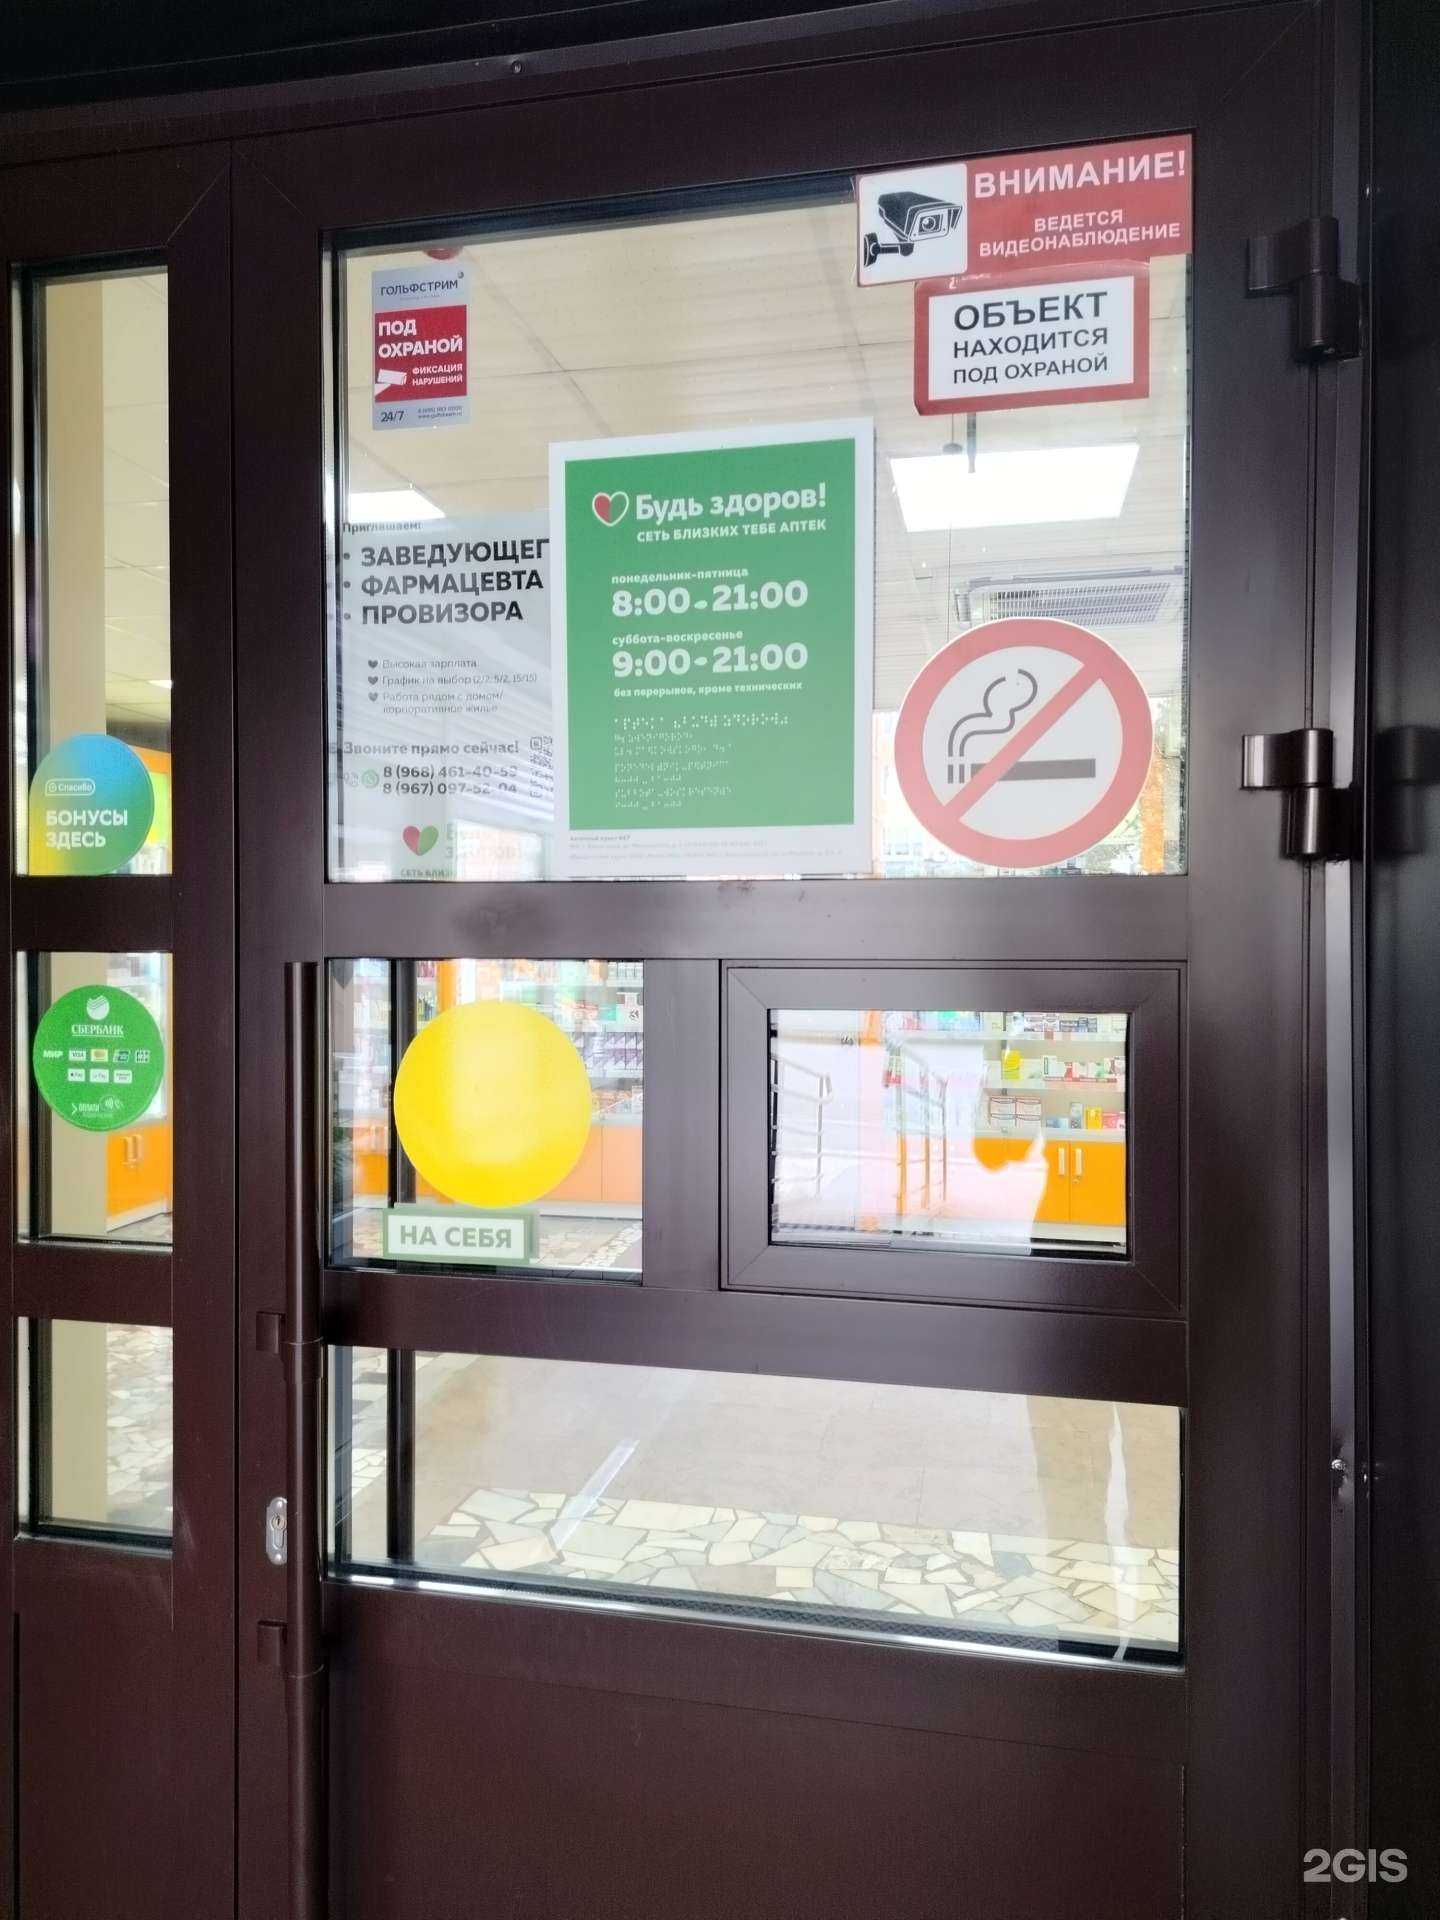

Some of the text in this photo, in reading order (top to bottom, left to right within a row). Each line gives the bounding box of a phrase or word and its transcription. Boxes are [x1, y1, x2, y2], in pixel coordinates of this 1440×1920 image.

[974, 150, 1187, 199] ВНИМАНИЕ!
[1034, 208, 1124, 234] ВЕДЕТСЯ
[979, 223, 1181, 258] ВИДЕОНАБЛЮДЕНИЕ
[380, 279, 459, 297] ГОЛЬФСТРИМ
[954, 291, 1108, 331] ОБЪЕКТ
[378, 319, 417, 337] ПОД
[378, 334, 463, 359] ОХРАНОЙ
[953, 327, 1108, 359] НАХОДИТСЯ
[412, 363, 463, 375] ФИКСАЦИЯ
[953, 352, 1108, 384] ПОД ОХРАНОЙ
[412, 374, 463, 386] НАРУШЕНИЙ
[380, 410, 405, 423] 24/7
[635, 482, 827, 525] Будь здоров!
[637, 519, 827, 542] СЕТЬ БЛИЗКИХ ТЕБЕ АПТЕК
[361, 538, 550, 568] ЗАВЕДУЮЩЕГ
[361, 569, 544, 597] ФАРМАЦЕВТА
[362, 600, 524, 625] ПРОВИЗОРА
[382, 675, 421, 687] График
[437, 673, 472, 685] выбор
[614, 682, 802, 699] без перерывов, кроме технических
[343, 740, 519, 758] Звоните прямо сейчас!
[383, 766, 392, 778] 8
[58, 782, 93, 792] Спасибо
[383, 782, 392, 794] 8
[396, 781, 434, 796] (967)
[46, 808, 128, 827] БОНУСЫ
[46, 831, 106, 850] ЗДЕСЬ
[71, 1024, 124, 1035] СБЕРБАНК
[43, 1050, 64, 1058] МИР
[400, 1225, 512, 1249] НА СЕБЯ
